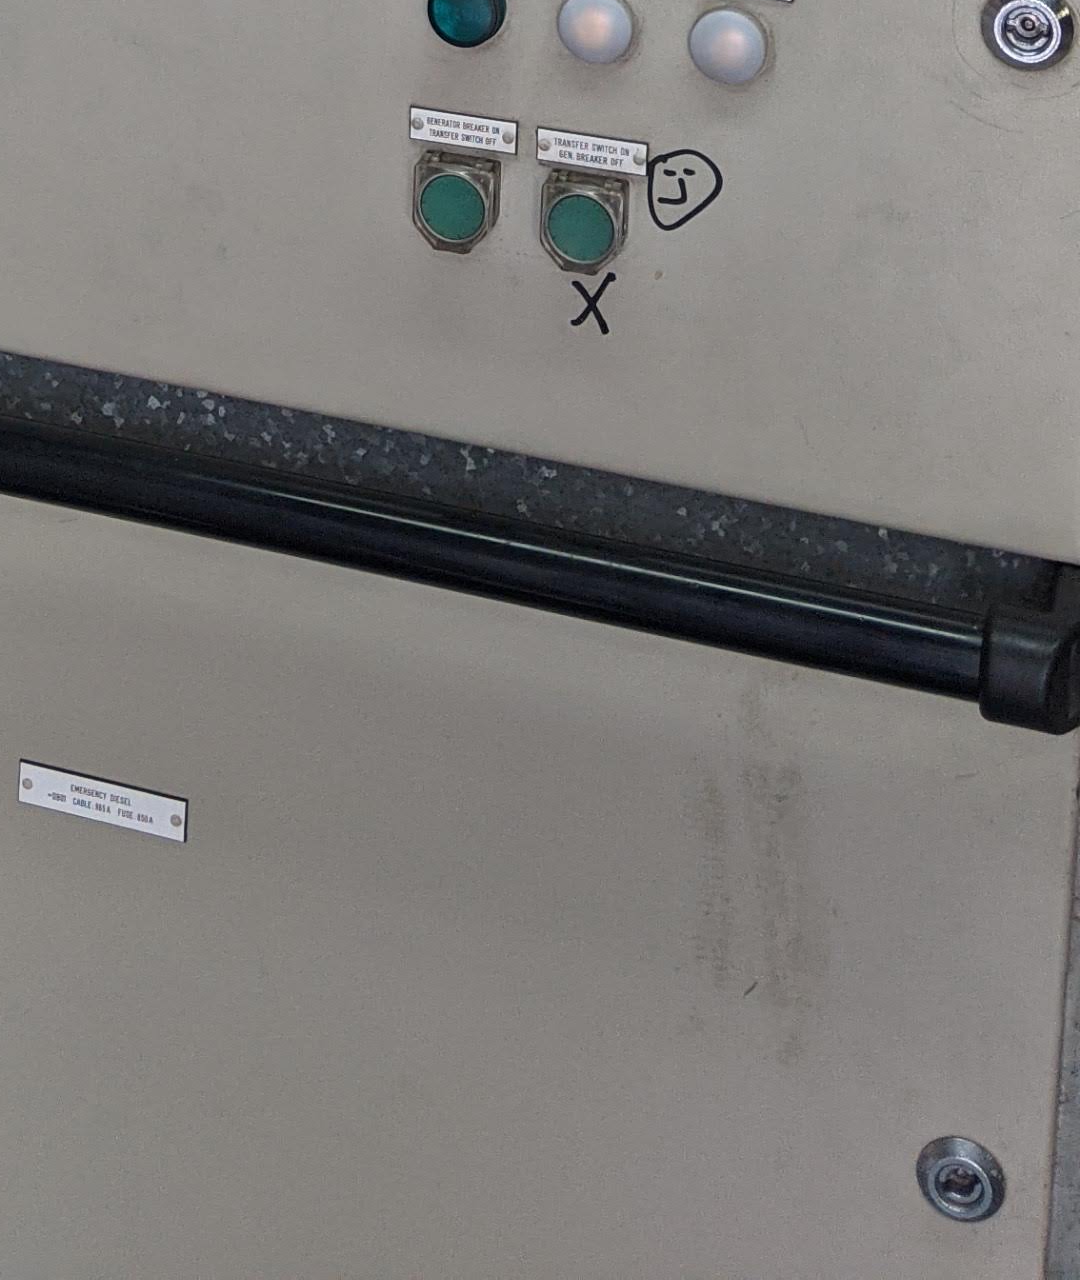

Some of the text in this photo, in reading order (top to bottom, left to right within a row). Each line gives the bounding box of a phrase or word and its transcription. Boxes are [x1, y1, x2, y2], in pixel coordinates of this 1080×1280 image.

[426, 117, 500, 135] GENERATOR BREAKER ON
[429, 128, 459, 141] TRANSFER
[461, 133, 483, 145] SWITCH
[554, 137, 630, 157] TRANSFER SWITCH ON
[576, 152, 608, 165] BREAKER
